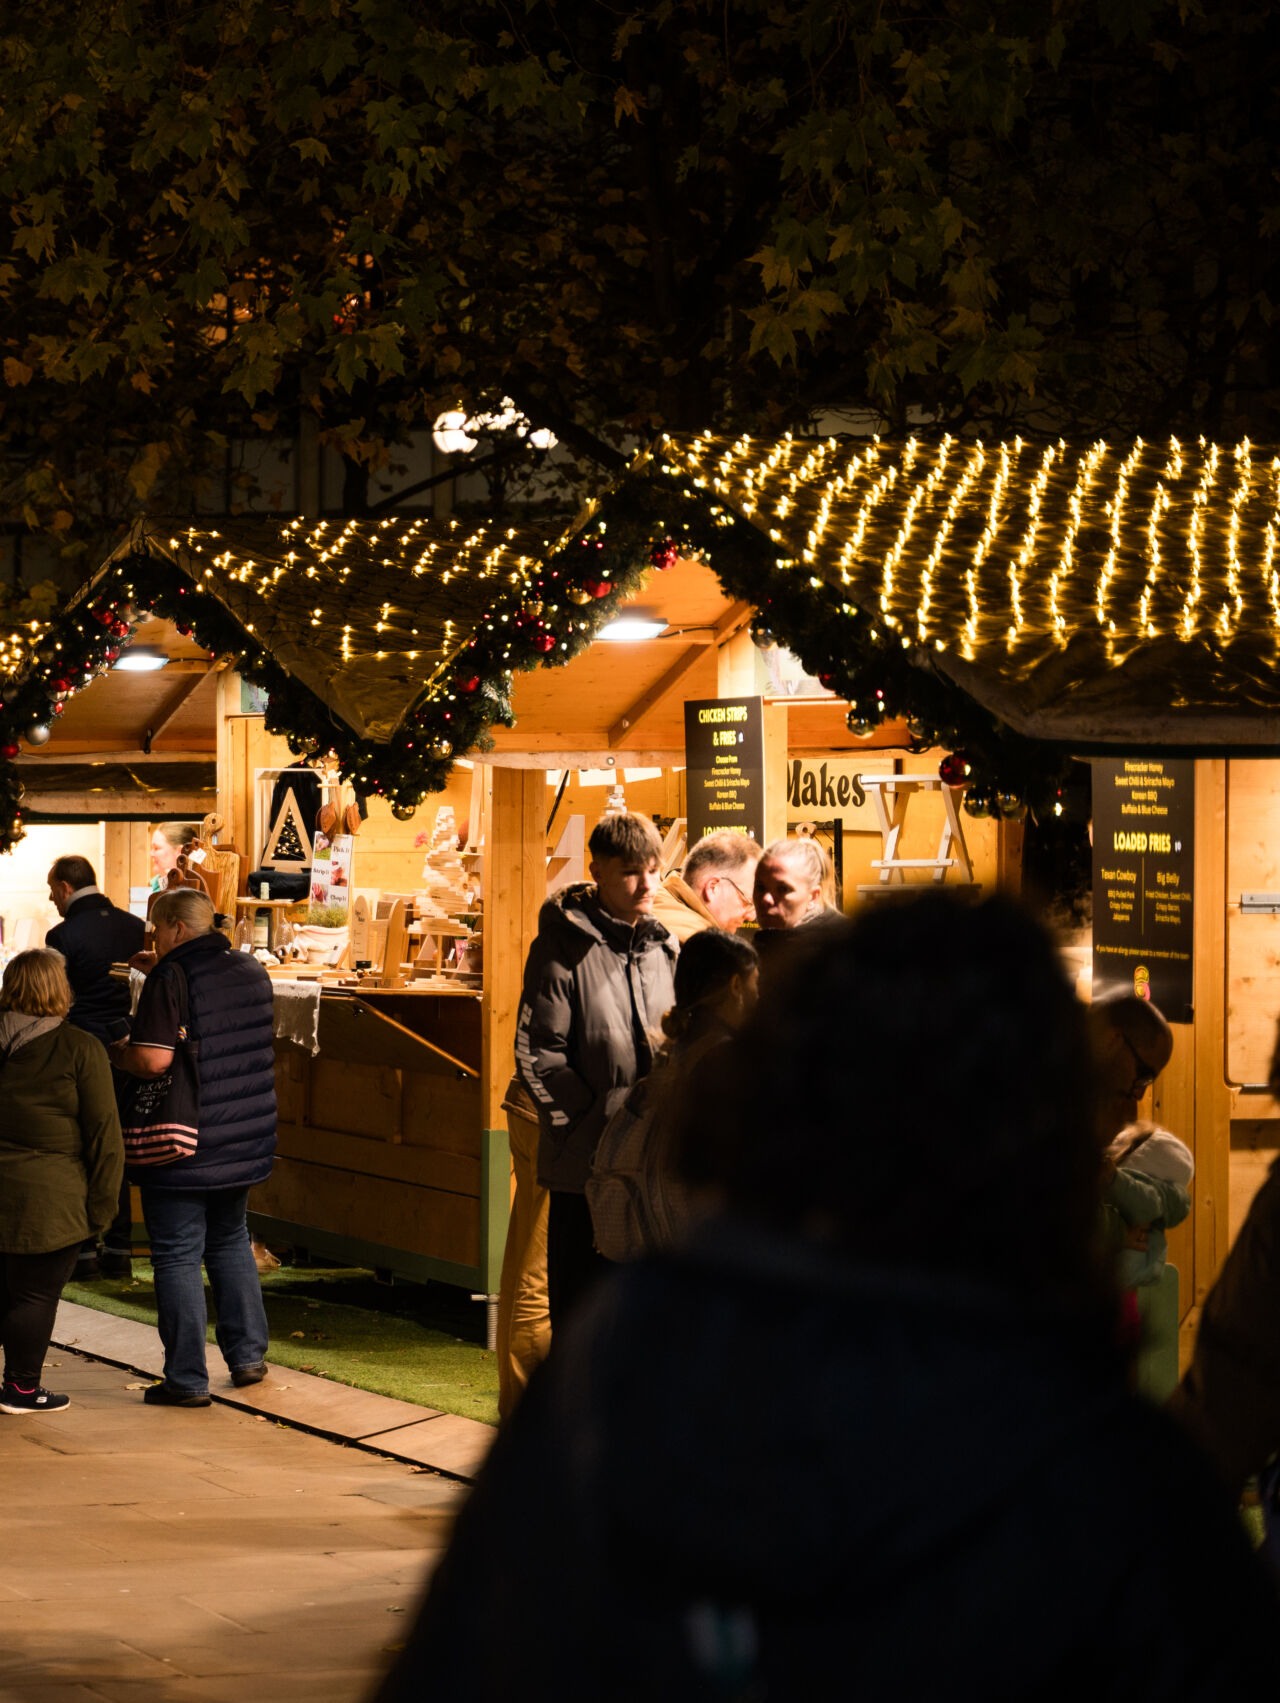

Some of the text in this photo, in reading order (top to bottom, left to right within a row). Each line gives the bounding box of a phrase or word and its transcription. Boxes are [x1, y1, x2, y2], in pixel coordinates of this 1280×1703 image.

[699, 706, 748, 723] CHICKEN STRIPS
[713, 731, 719, 746] &
[720, 730, 737, 746] FRIES
[1148, 762, 1163, 774] Honey
[1115, 775, 1128, 787] Sweet
[1162, 776, 1175, 789] Mayo
[1131, 790, 1158, 802] Korean BBQ
[1121, 803, 1137, 814] Buffalo
[1141, 804, 1151, 815] Blue
[1151, 805, 1168, 815] Cheese
[1114, 831, 1147, 851] LOADED
[1149, 832, 1171, 853] FRIES
[1101, 868, 1137, 884] Texan Cowboy
[1156, 872, 1180, 886] Big Belly
